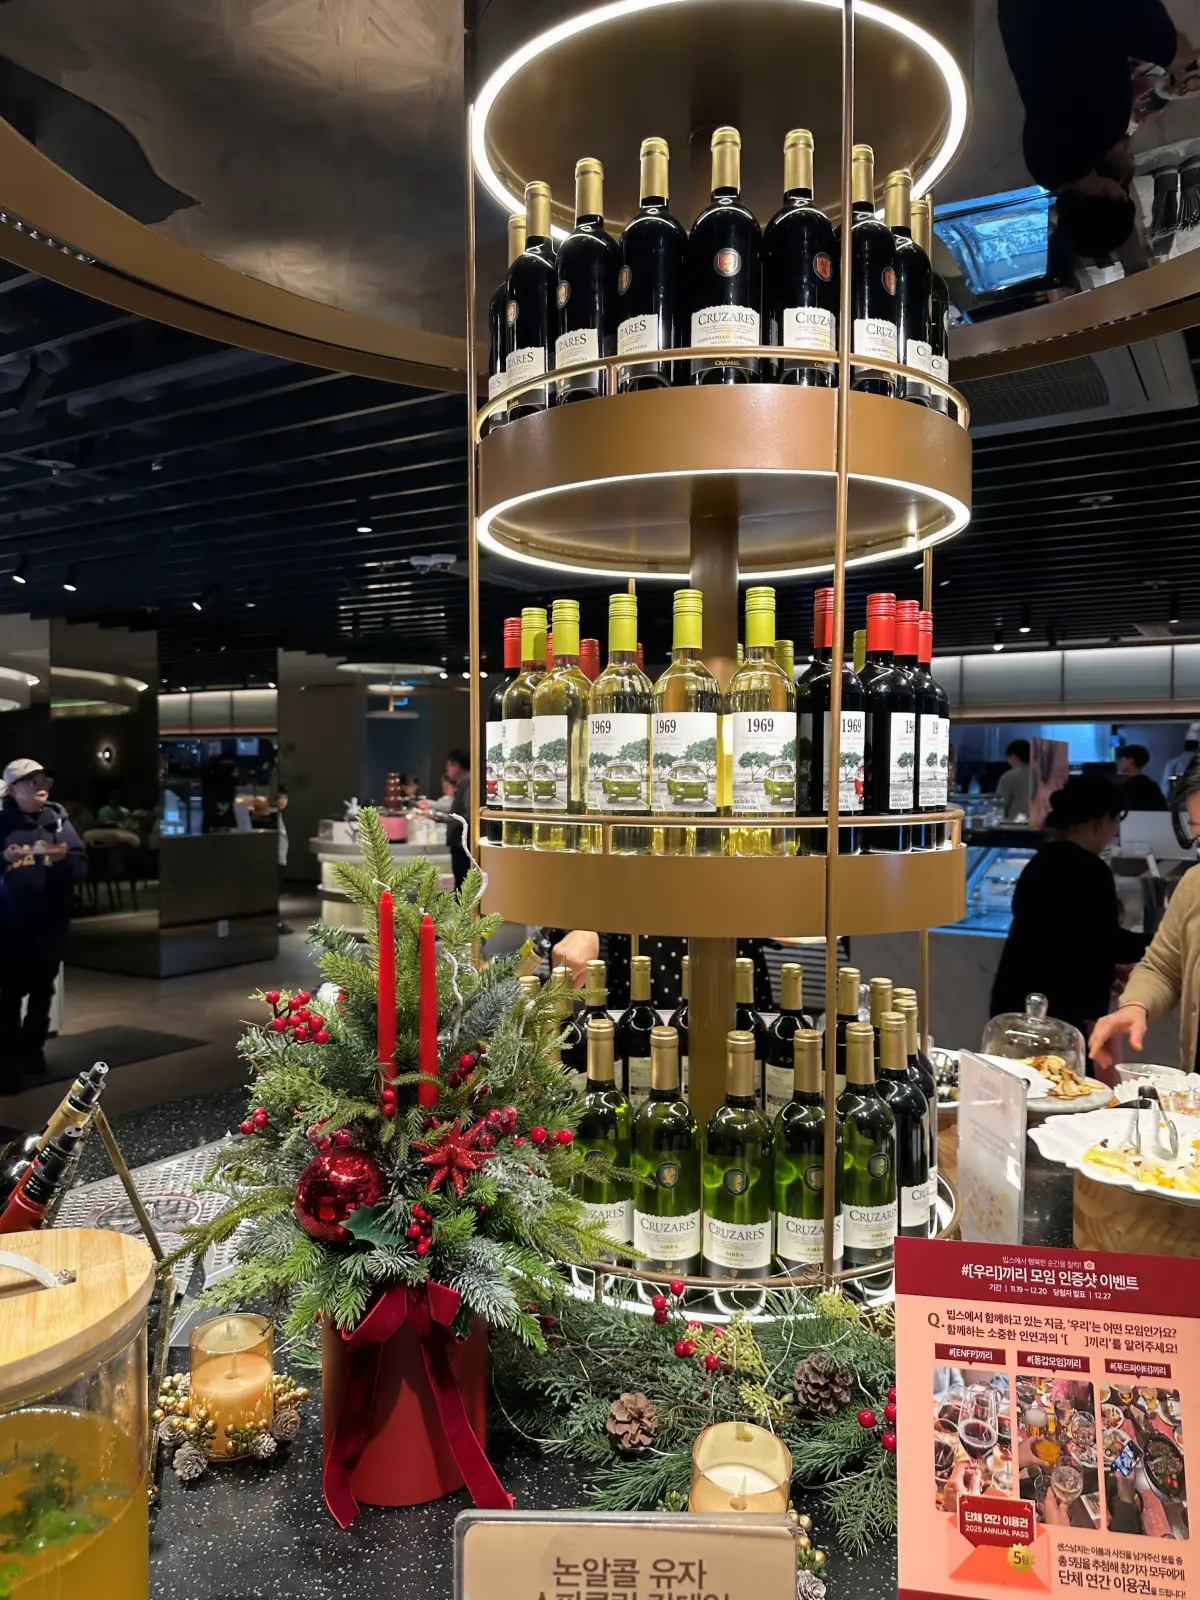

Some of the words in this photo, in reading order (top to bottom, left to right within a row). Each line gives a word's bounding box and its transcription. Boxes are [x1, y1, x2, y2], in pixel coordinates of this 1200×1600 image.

[698, 312, 755, 326] CRUZARES
[591, 719, 612, 734] 1969
[655, 719, 677, 734] 1969
[747, 717, 774, 733] 1969
[841, 718, 862, 733] 1969
[640, 1217, 696, 1233] CRUZARES
[708, 1222, 765, 1241] CRUZARES
[961, 1263, 1027, 1283] #[우리]끼리
[1030, 1269, 1056, 1285] 모임
[1058, 1271, 1098, 1288] 인증샷
[1100, 1274, 1139, 1290] 이벤트
[989, 1283, 1002, 1292] 기간
[1053, 1288, 1072, 1297] 당첨자
[1073, 1290, 1086, 1298] 발표
[1094, 1292, 1111, 1300] 12.27
[927, 1312, 945, 1328] Q.
[946, 1309, 983, 1323] 빕스에서
[984, 1312, 1022, 1325] 함께하고
[1023, 1315, 1042, 1327] 있는
[1044, 1317, 1066, 1331] 지금,
[1103, 1322, 1123, 1335] 어떤
[1124, 1324, 1177, 1339] 모임인가요?
[946, 1323, 985, 1338] 함께하는
[987, 1328, 1016, 1341] 소중한
[1019, 1331, 1058, 1344] 인연과의
[1124, 1339, 1178, 1354] 알려주세요!
[948, 1347, 993, 1361] #[ENFP]끼리
[1026, 1355, 1082, 1369] #[동갑모임]끼리
[965, 1511, 983, 1522] 단체
[983, 1513, 1001, 1524] 연간
[1002, 1516, 1029, 1528] 이용권
[965, 1525, 982, 1533] 2025
[983, 1526, 1011, 1536] ANNUAL
[1011, 1530, 1029, 1538] PASS
[1013, 1551, 1029, 1565] 5팀
[1057, 1542, 1090, 1555] 센스넘치는
[1090, 1546, 1111, 1557] 이름과
[1112, 1549, 1132, 1560] 사진을
[1133, 1551, 1160, 1563] 남겨주신
[1161, 1554, 1175, 1565] 분들
[1176, 1556, 1184, 1565] 중
[552, 1556, 640, 1588] 논알콜
[649, 1557, 707, 1589] 유자
[1058, 1555, 1067, 1567] 총
[1068, 1556, 1091, 1570] 5팀을
[1092, 1558, 1119, 1573] 추첨해
[1120, 1561, 1148, 1577] 참가자
[1149, 1566, 1185, 1582] 모두에게
[1058, 1570, 1083, 1588] 단체
[1085, 1573, 1111, 1590] 연간
[1113, 1576, 1157, 1596] 이용권을
